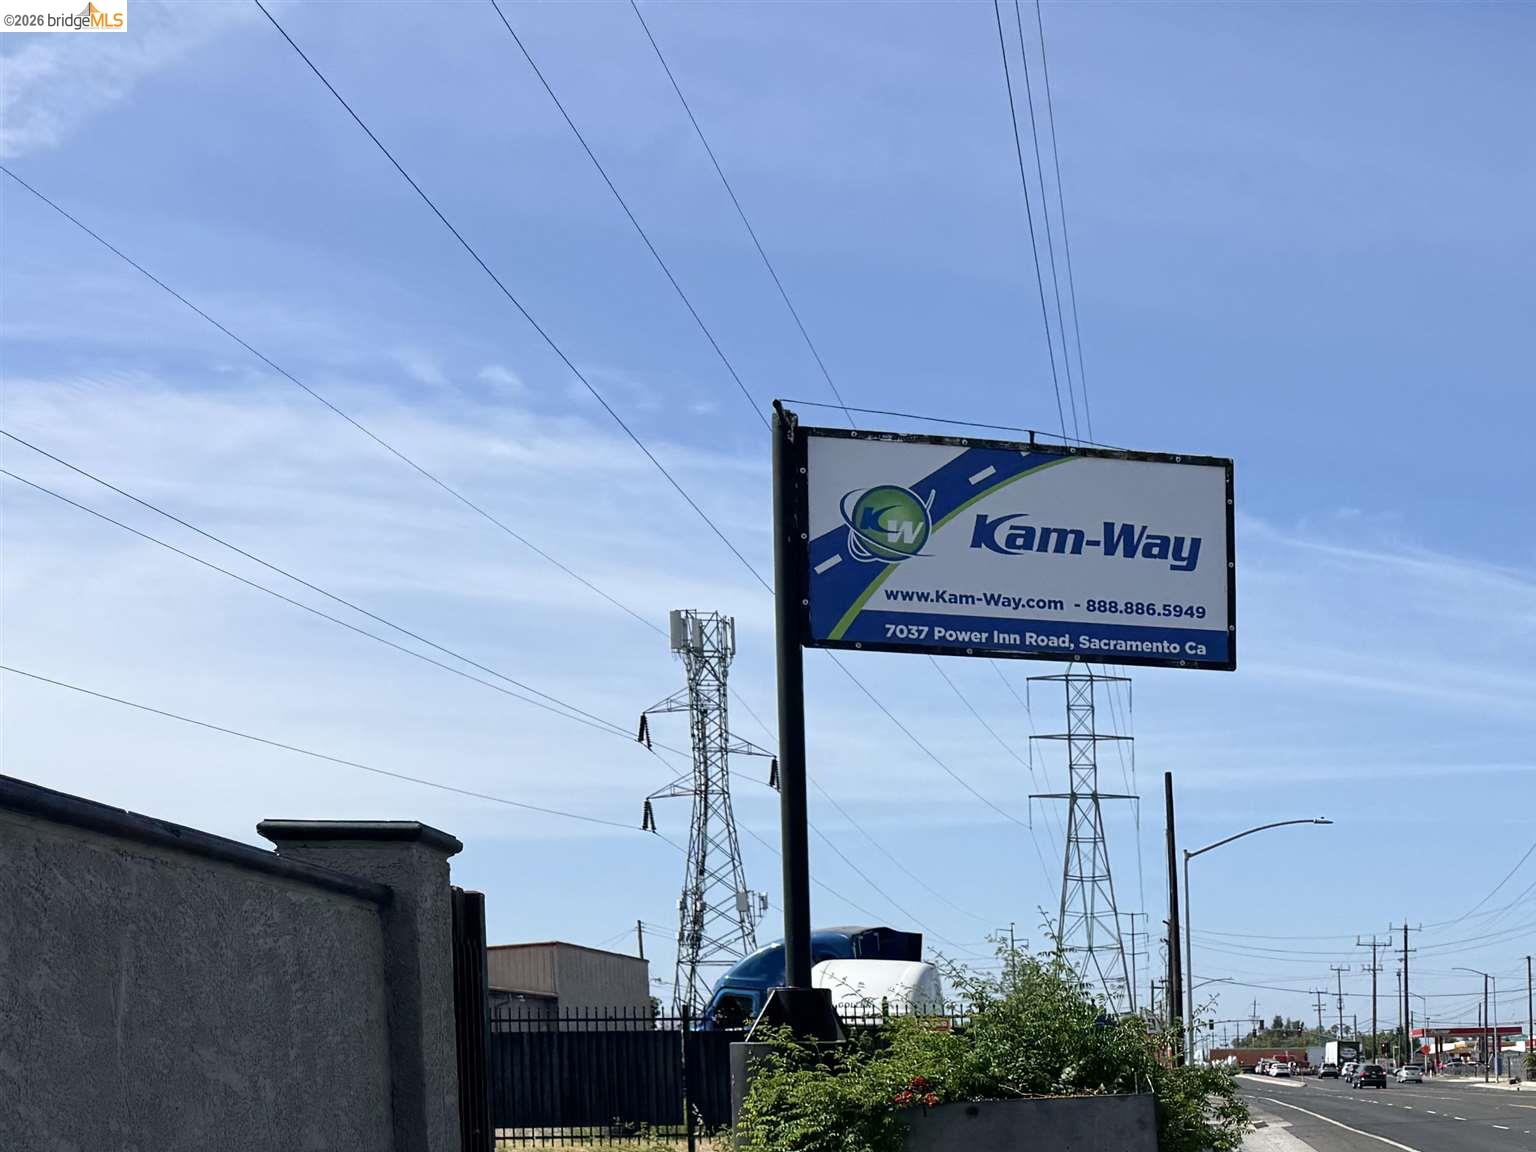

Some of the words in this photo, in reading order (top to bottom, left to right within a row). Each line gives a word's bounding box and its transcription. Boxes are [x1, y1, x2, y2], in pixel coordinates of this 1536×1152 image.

[970, 513, 1202, 572] Kam-Way
[884, 589, 1064, 611] www.Kam-Way.com
[1086, 599, 1206, 619] 888.886.5949
[885, 624, 929, 640] 7037
[934, 626, 989, 644] Power
[993, 630, 1020, 645] Inn
[1025, 632, 1075, 650] Road,
[1079, 635, 1180, 653] Sacramento
[1185, 641, 1206, 656] Ca
